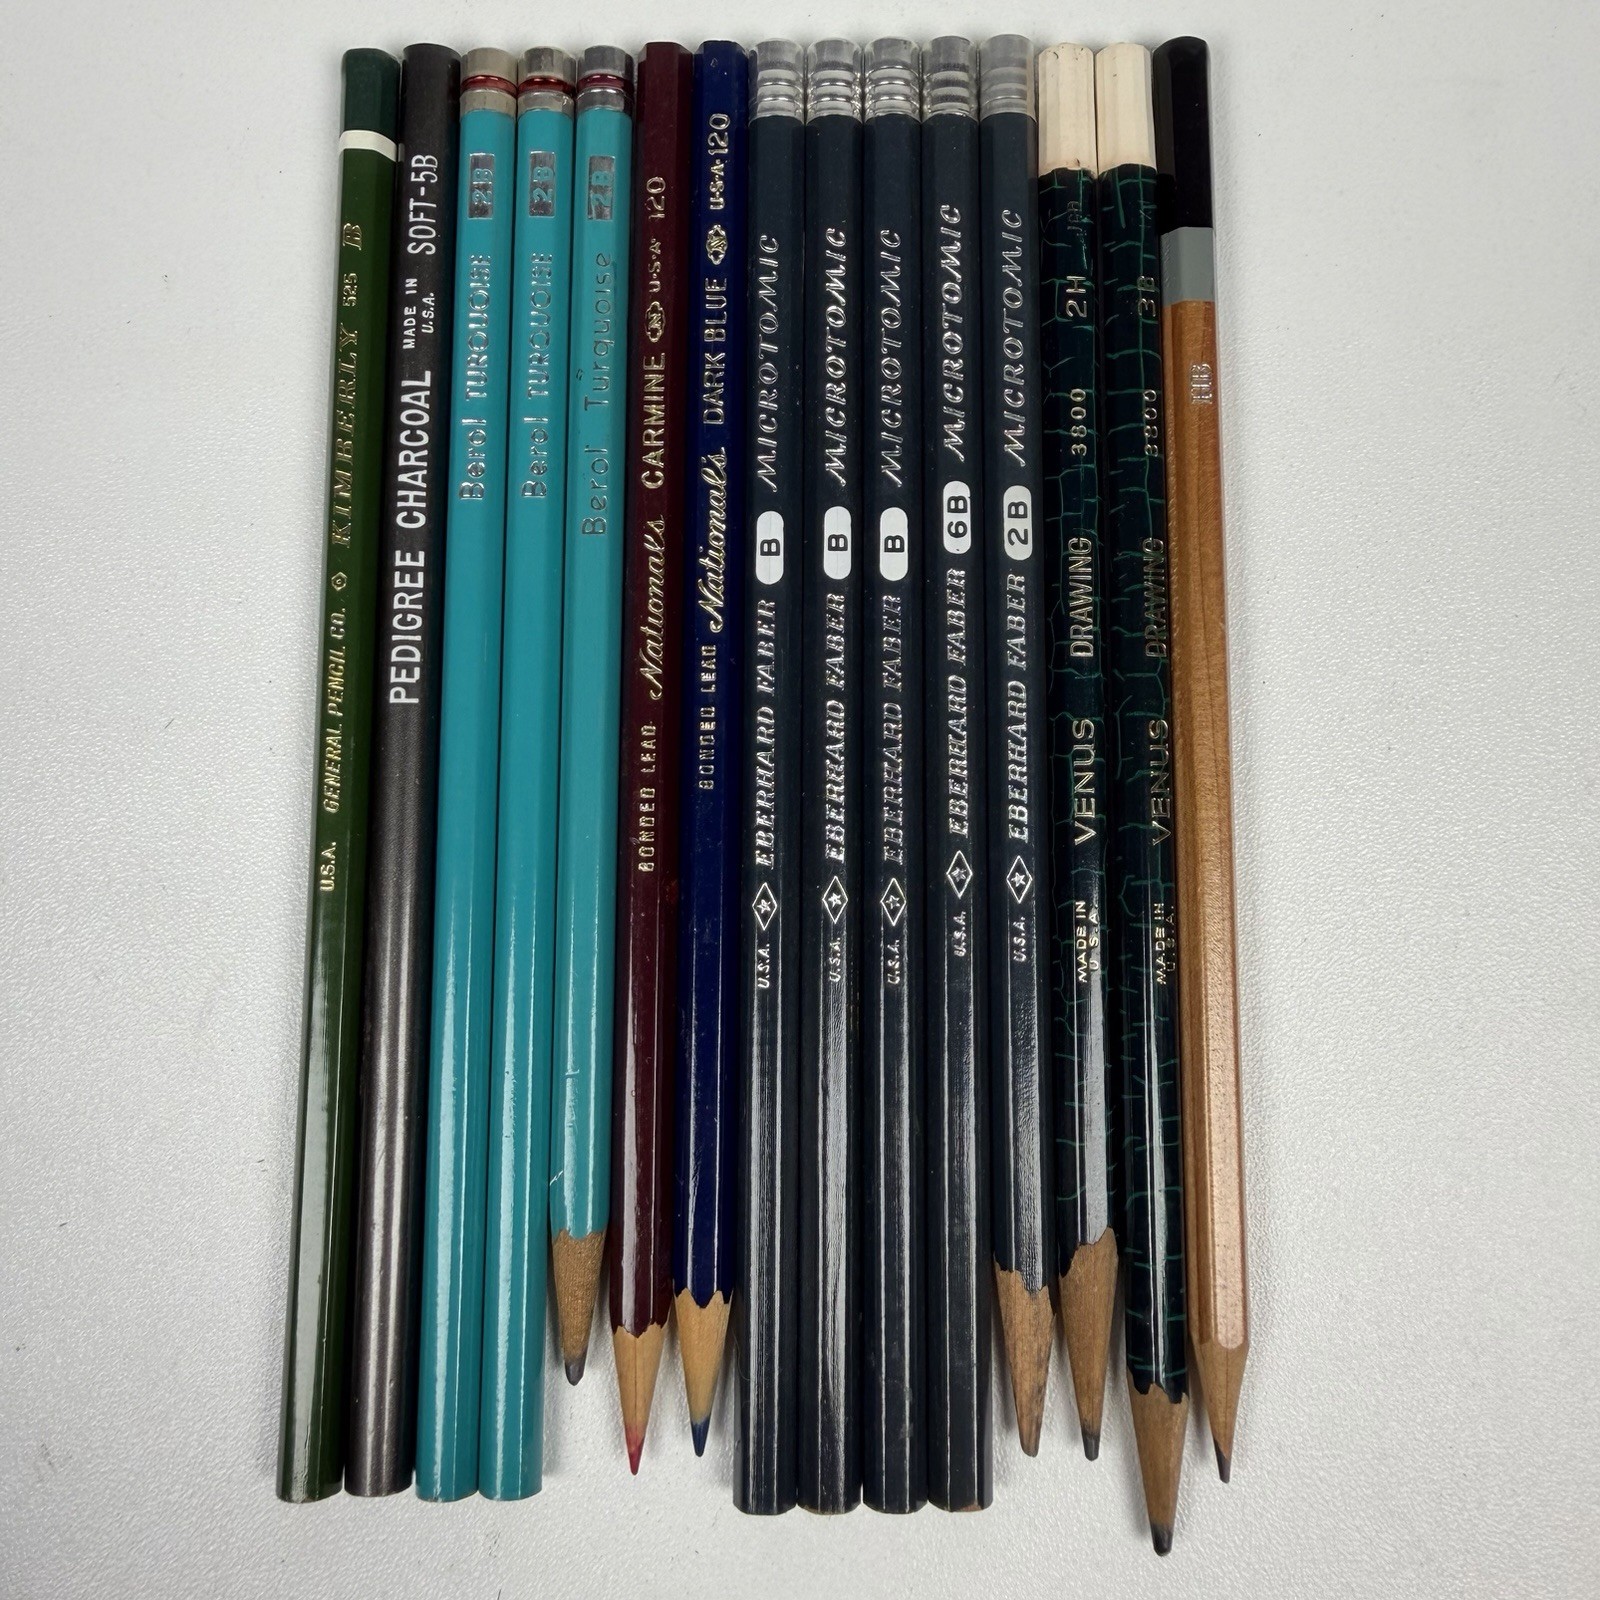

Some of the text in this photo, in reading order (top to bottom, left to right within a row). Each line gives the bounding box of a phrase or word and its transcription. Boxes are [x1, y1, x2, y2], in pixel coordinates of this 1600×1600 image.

[532, 166, 553, 202] 2B
[708, 113, 730, 155] 120
[407, 154, 439, 255] SOFT-5B
[472, 167, 493, 204] 2B
[646, 176, 666, 220] 120
[402, 278, 418, 349] MADE IN
[422, 292, 436, 334] U.S.A.
[703, 277, 728, 342] BLUE
[824, 228, 848, 486] MICROTOMIC
[880, 230, 903, 487] MICROTOMIC
[940, 204, 966, 462] MICROTOMIC
[1002, 209, 1026, 466] MICROTOMIC
[332, 223, 362, 549] KIMBERLY 525 B
[458, 253, 492, 500] Berol TURQUOISE
[520, 252, 552, 498] Berol TURQUOISE
[581, 252, 615, 535] Berol Turquoise
[702, 352, 726, 425] DARK
[756, 234, 779, 492] MICROTOMIC
[640, 352, 666, 489] CARMINE
[388, 370, 432, 704] PEDIGREE CHARCOAL
[760, 538, 781, 556] B
[828, 534, 848, 552] B
[884, 535, 905, 554] B
[947, 496, 968, 538] 6B
[1066, 275, 1097, 846] VENUS DRAWING 3800 2H
[1137, 275, 1171, 846] VENUS DRAWING 3800 3B
[700, 644, 717, 693] LEAD
[320, 608, 346, 891] U.S.A. GENERAL PENCIL CO.
[639, 724, 657, 773] LEAD
[698, 706, 716, 790] BONDED
[754, 600, 776, 989] U.S.A. EBERHARD FABER
[824, 593, 846, 982] U.S.A. EBERHARD FABER
[880, 595, 903, 984] U.S.A. EBERHARD FABER
[946, 568, 969, 957] U.S.A. EBERHARD FABER
[1006, 574, 1029, 962] U.S.A. EBERHARD FABER
[638, 787, 656, 872] BONDED
[1075, 901, 1088, 982] MADE IN
[1088, 903, 1099, 970] US.A.
[1154, 903, 1166, 984] MADE IN
